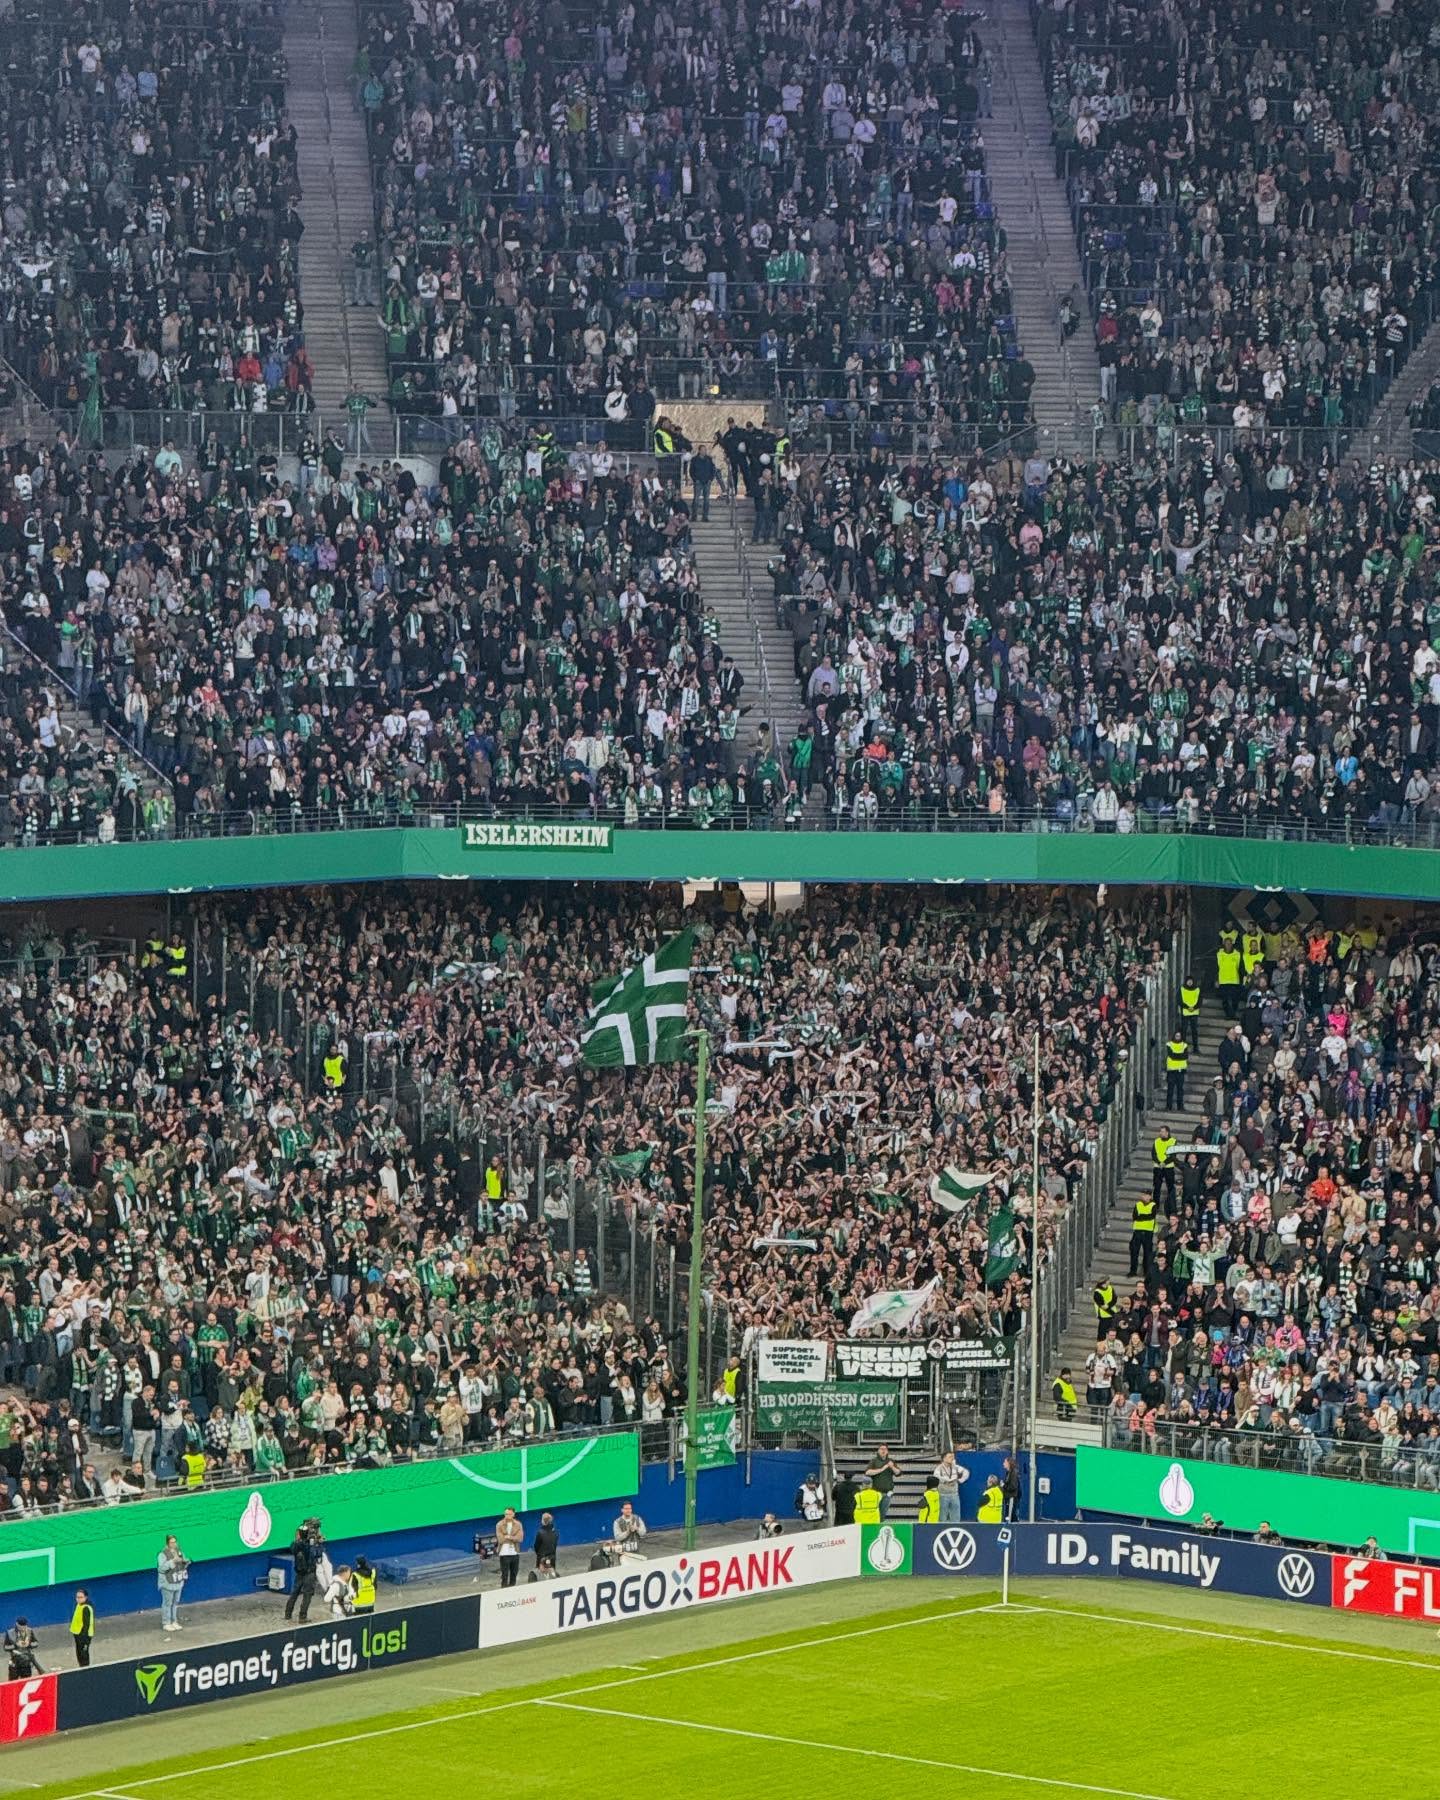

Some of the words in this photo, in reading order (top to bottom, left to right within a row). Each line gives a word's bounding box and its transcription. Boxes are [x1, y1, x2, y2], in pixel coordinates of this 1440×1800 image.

[465, 823, 610, 847] ISELERSHEIM
[946, 1340, 984, 1349] FORZA
[791, 1353, 822, 1361] LOCAL
[946, 1350, 993, 1359] WERDER
[772, 1360, 813, 1368] WOMEN'S
[841, 1360, 923, 1377] VERDE
[758, 1394, 776, 1408] HB
[777, 1392, 858, 1407] NORDHESSEN
[859, 1393, 896, 1407] CREW
[1047, 1533, 1100, 1566] ID.
[1111, 1535, 1221, 1587] Family
[173, 1650, 278, 1695] freenet,
[281, 1633, 358, 1674] fertig,
[362, 1624, 408, 1659] los!
